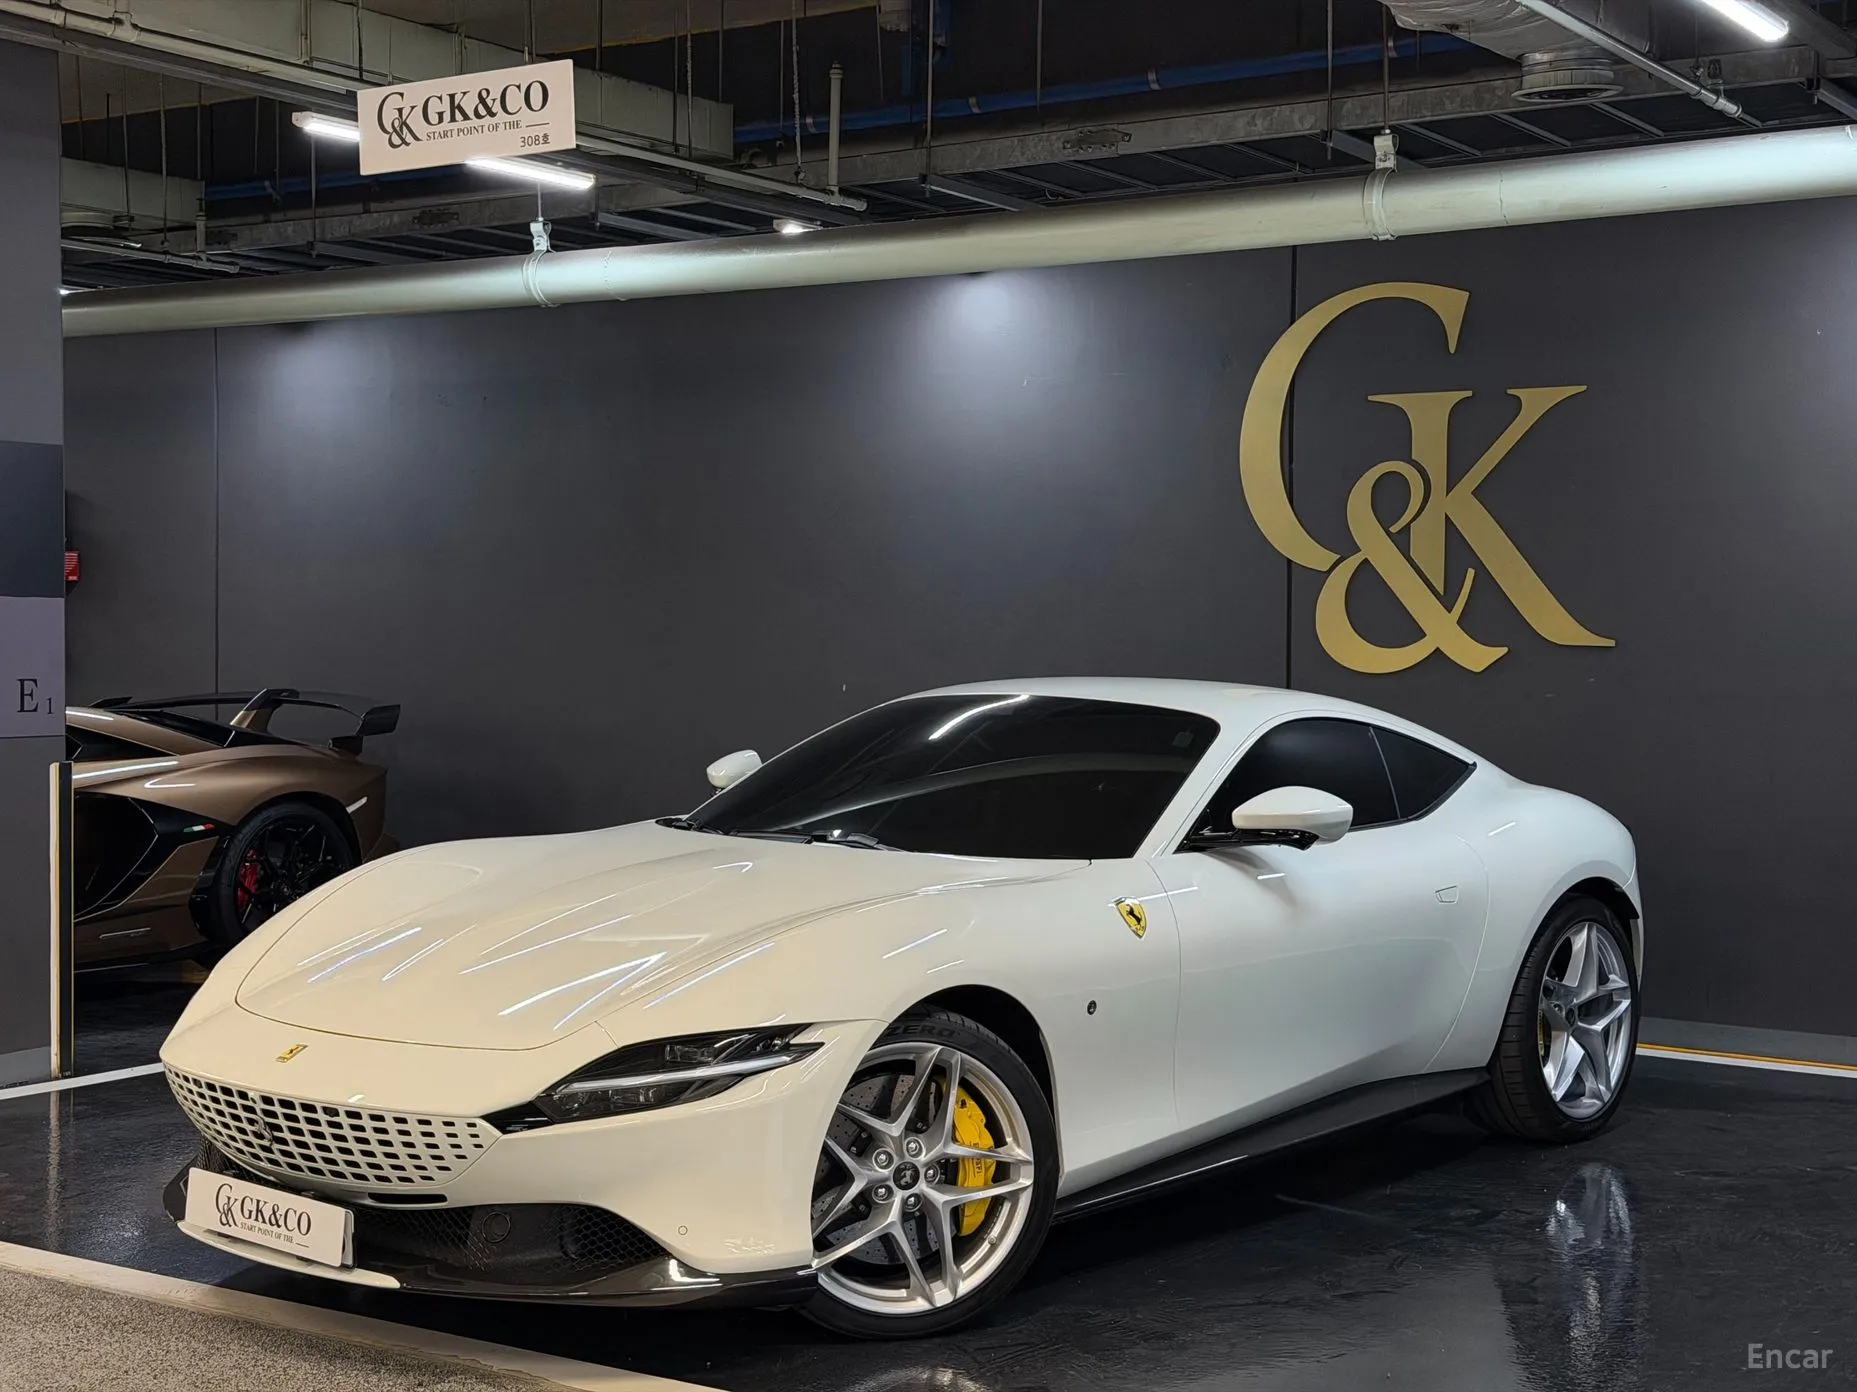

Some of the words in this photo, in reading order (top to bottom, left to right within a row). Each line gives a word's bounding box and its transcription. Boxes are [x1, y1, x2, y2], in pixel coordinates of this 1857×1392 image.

[421, 79, 550, 127] GK&CO
[425, 127, 456, 141] START
[456, 125, 486, 138] POINT
[487, 122, 501, 134] OF
[502, 120, 523, 131] THE
[520, 133, 551, 148] 308호
[885, 1024, 956, 1038] ZERO
[240, 1195, 312, 1236] GK&CO
[240, 1221, 257, 1234] START
[257, 1227, 275, 1239] POINT
[274, 1231, 283, 1240] OF
[282, 1234, 294, 1244] THE
